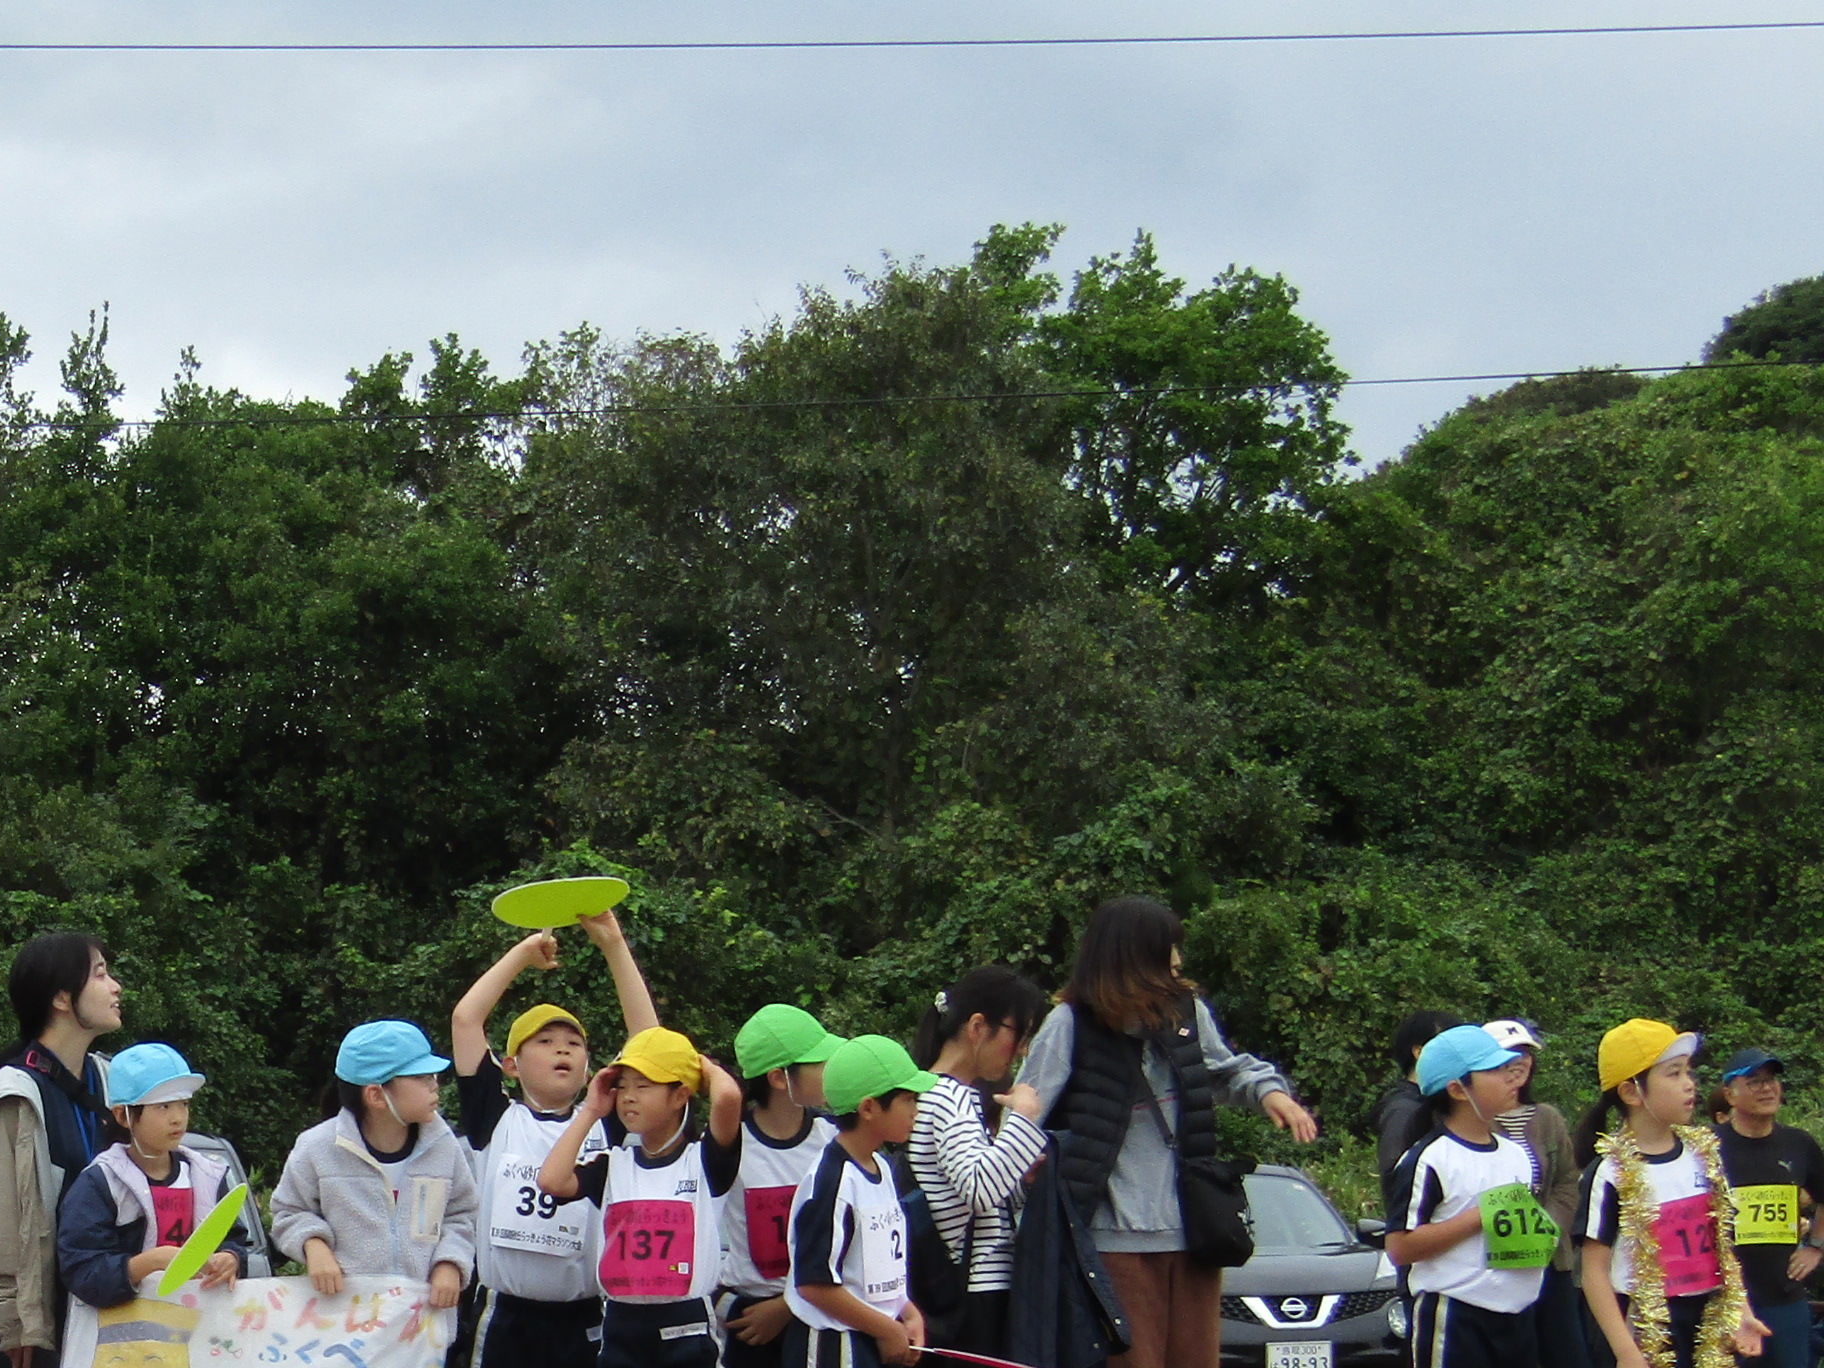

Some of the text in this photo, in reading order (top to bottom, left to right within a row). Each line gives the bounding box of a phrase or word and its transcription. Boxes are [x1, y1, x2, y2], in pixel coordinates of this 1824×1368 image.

[516, 1186, 558, 1219] 39
[1748, 1203, 1787, 1223] 755
[617, 1229, 675, 1260] 137
[772, 1215, 785, 1243] 1
[233, 1286, 444, 1349] がんばれ
